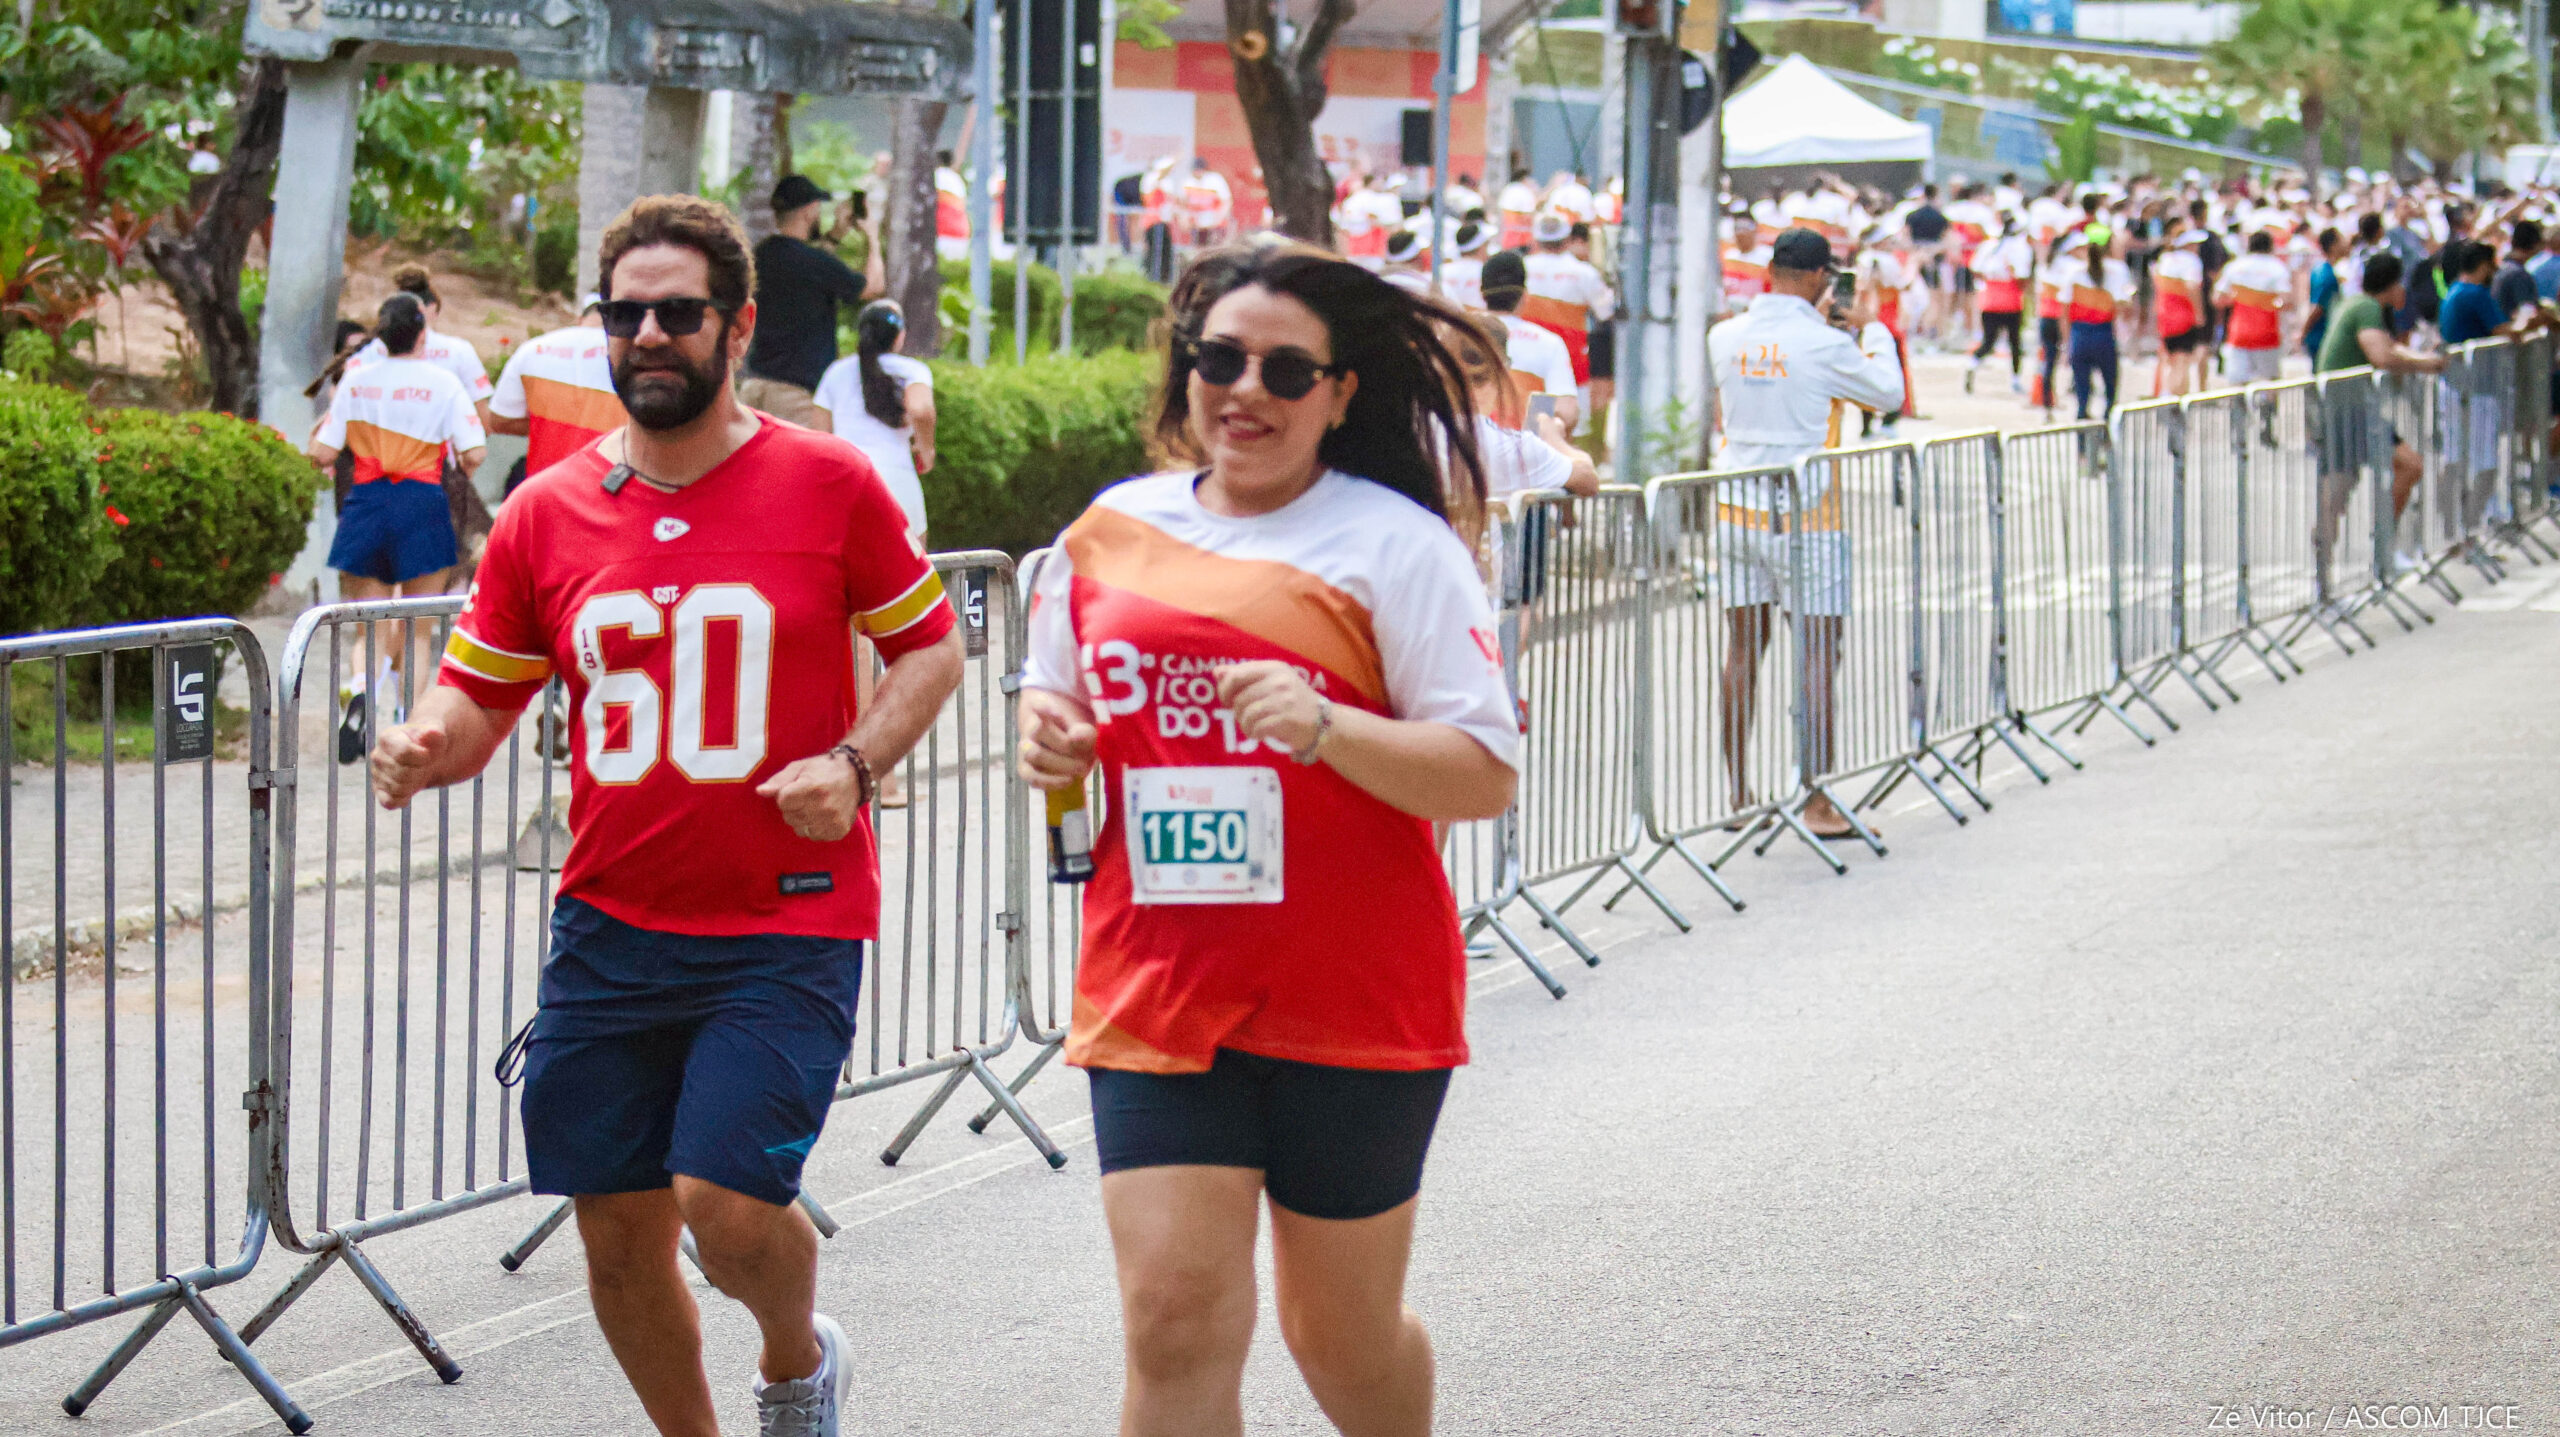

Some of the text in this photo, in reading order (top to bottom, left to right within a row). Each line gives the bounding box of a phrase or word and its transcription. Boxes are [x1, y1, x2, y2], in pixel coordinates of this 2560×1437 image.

[573, 583, 776, 786] 60
[1157, 706, 1210, 738] DO
[1144, 812, 1246, 861] 1150
